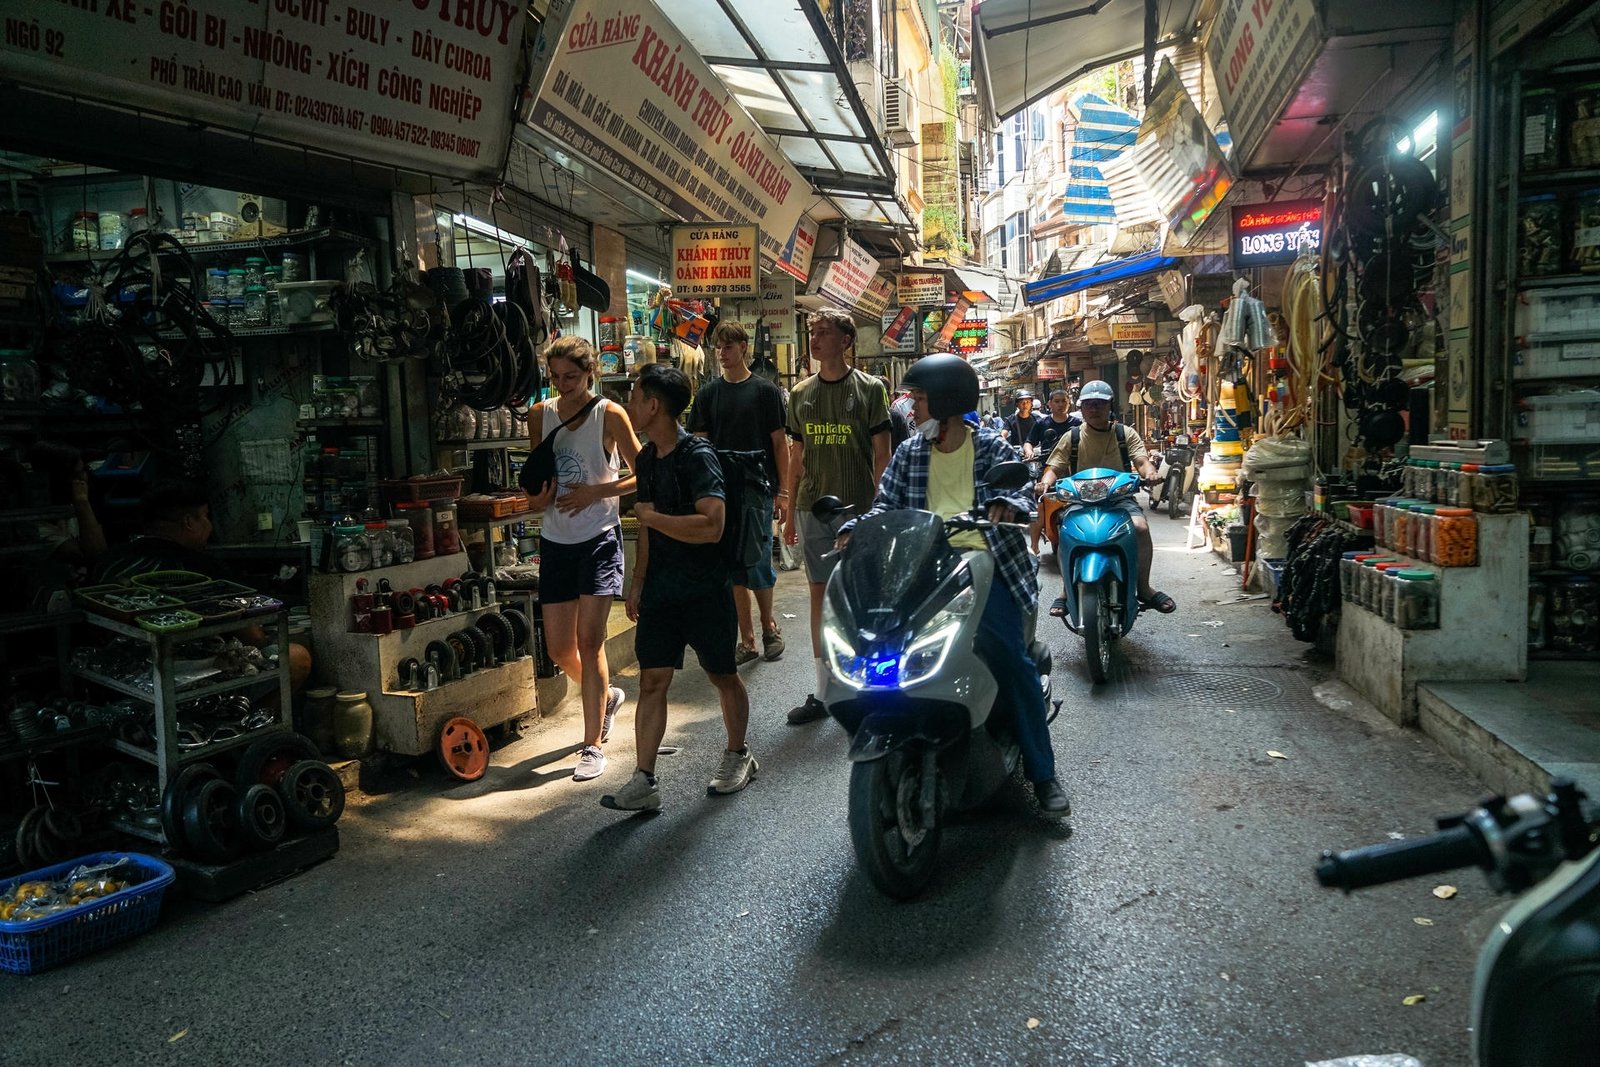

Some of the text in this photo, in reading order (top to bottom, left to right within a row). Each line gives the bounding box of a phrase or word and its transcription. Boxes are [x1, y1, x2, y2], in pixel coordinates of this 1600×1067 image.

[45, 28, 64, 57] 92
[569, 11, 641, 49] CỬA HÀNG
[346, 7, 389, 46] BULY
[411, 30, 443, 64] DÂY
[444, 43, 491, 82] CUROA
[205, 14, 226, 49] BI
[244, 26, 311, 75] NHÔNG
[376, 66, 422, 104] CÔNG
[1225, 22, 1254, 96] LONG
[151, 53, 178, 86] PHỐ
[182, 60, 215, 96] TRẦN
[218, 75, 242, 102] CAO
[544, 111, 555, 128] Số
[564, 125, 576, 142] 22
[632, 25, 699, 112] KHÁNH
[691, 87, 733, 145] THỦY
[730, 131, 763, 180] OÁNH
[758, 153, 792, 206] KHÁNH
[663, 119, 681, 143] KINH
[690, 229, 738, 240] CỬA HÀNG
[1241, 233, 1284, 255] LONG
[677, 244, 717, 261] KHÁNH
[719, 242, 751, 260] THỦY
[676, 263, 708, 280] OÁNH
[711, 262, 752, 279] KHÁNH
[692, 285, 702, 293] 04
[706, 284, 727, 292] 3978
[730, 284, 751, 292] 3565
[805, 422, 852, 435] Emirates
[814, 435, 824, 445] FLY
